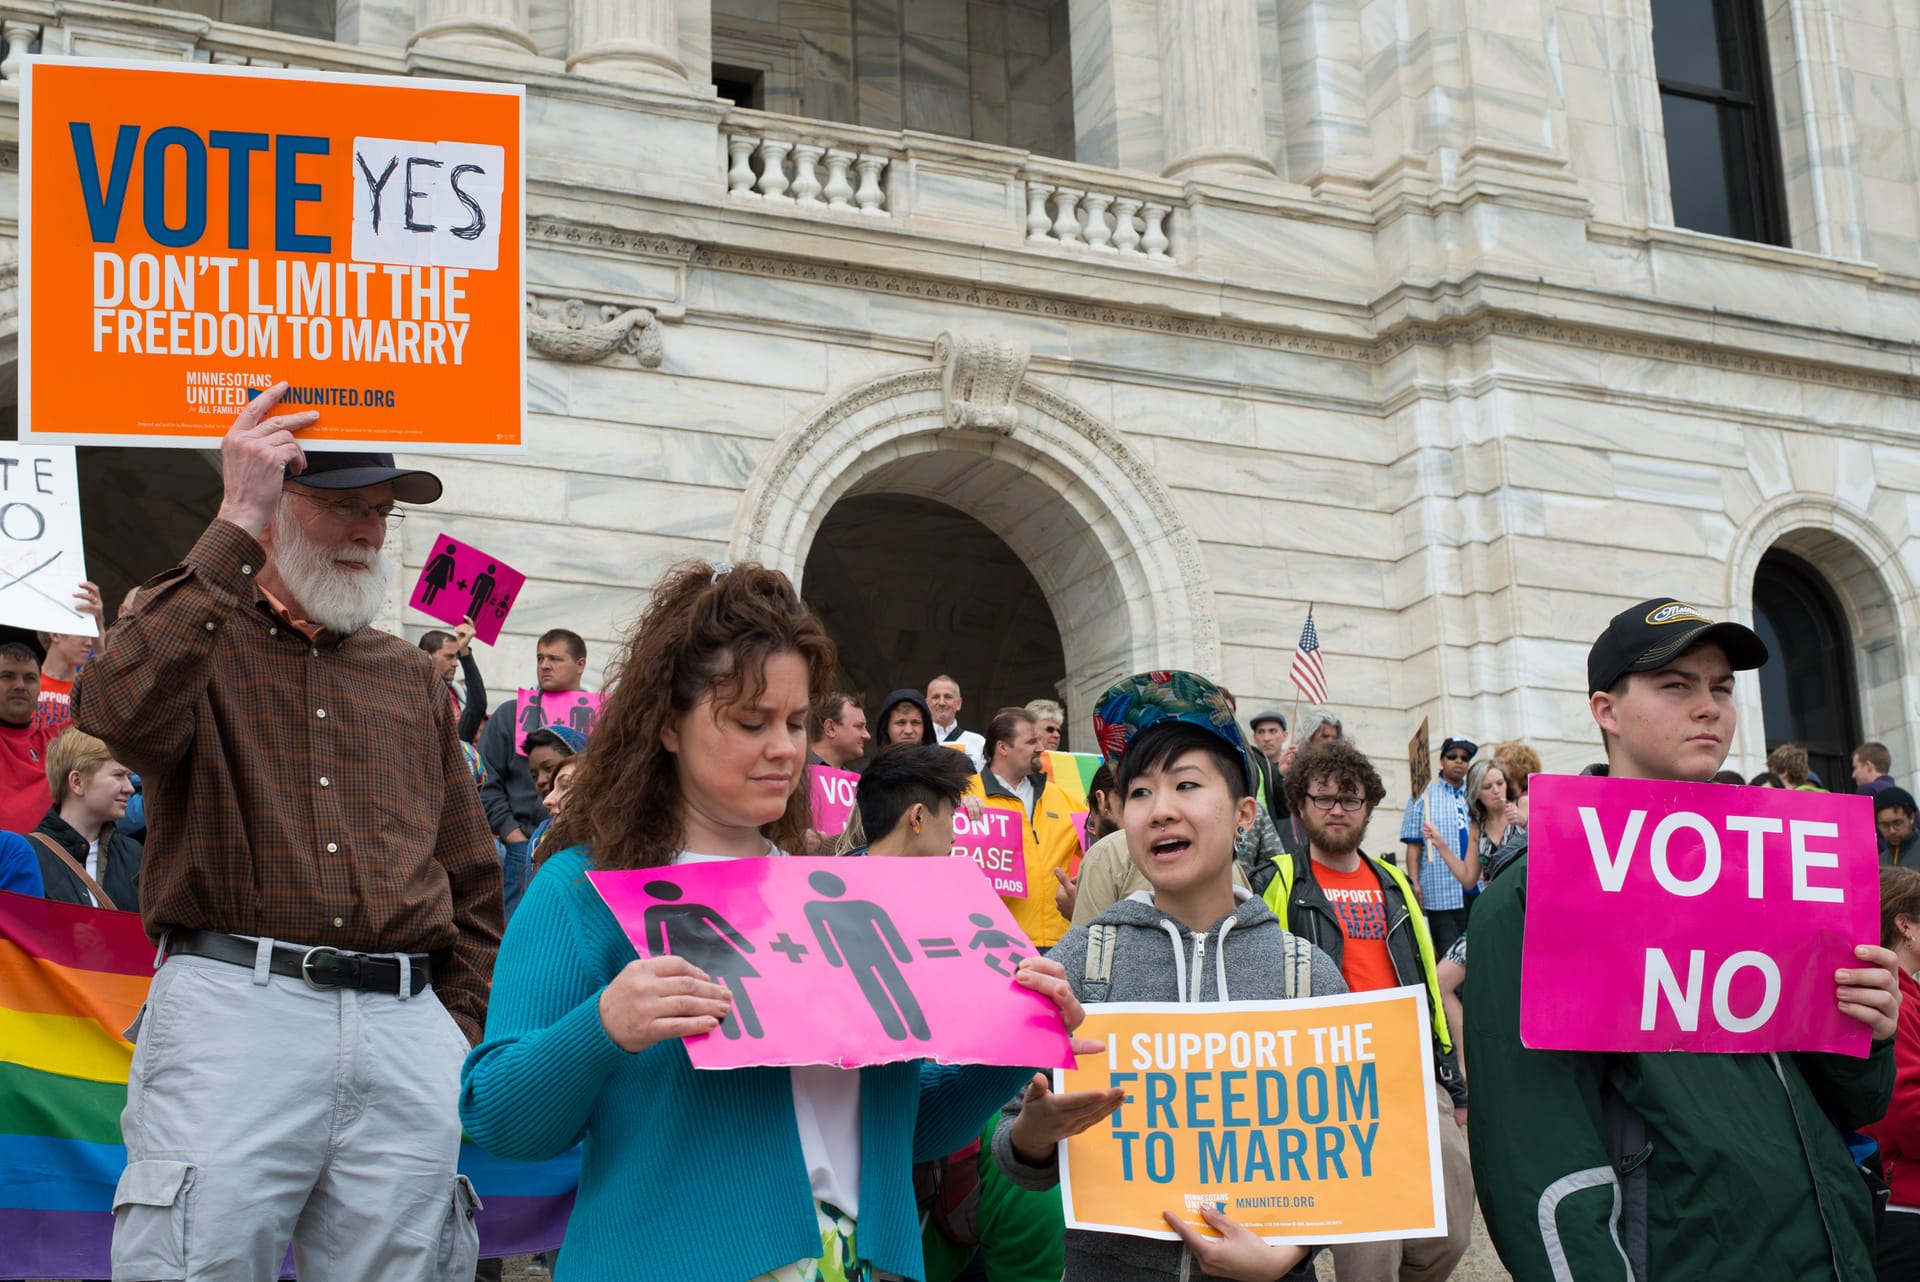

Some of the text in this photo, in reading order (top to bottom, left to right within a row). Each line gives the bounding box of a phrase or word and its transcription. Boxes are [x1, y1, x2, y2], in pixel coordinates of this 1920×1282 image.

[69, 122, 332, 254] VOTE
[356, 151, 487, 241] YES
[93, 251, 471, 323] DON'T LIMIT THE
[93, 309, 470, 365] FREEDOM TO MARRY
[186, 371, 272, 387] MINNESOTANS
[186, 386, 395, 408] UNITED MNUNITED.ORG
[198, 405, 211, 414] ALL
[0, 457, 53, 495] TE
[0, 502, 45, 541] O
[36, 702, 70, 719] REED
[37, 691, 71, 705] UPPOR
[819, 775, 858, 807] VO
[952, 812, 1010, 837] ON'T
[1577, 806, 1845, 904] VOTE
[994, 877, 1024, 893] DADS
[1323, 888, 1373, 903] UPPORT
[1346, 920, 1386, 940] MAR
[1640, 947, 1781, 1033] NO
[1108, 1022, 1376, 1071] I SUPPORT THE
[1110, 1062, 1380, 1129] FREEDOM
[1112, 1122, 1380, 1185] TO MARRY
[1235, 1195, 1315, 1209] MNUNITED.ORG
